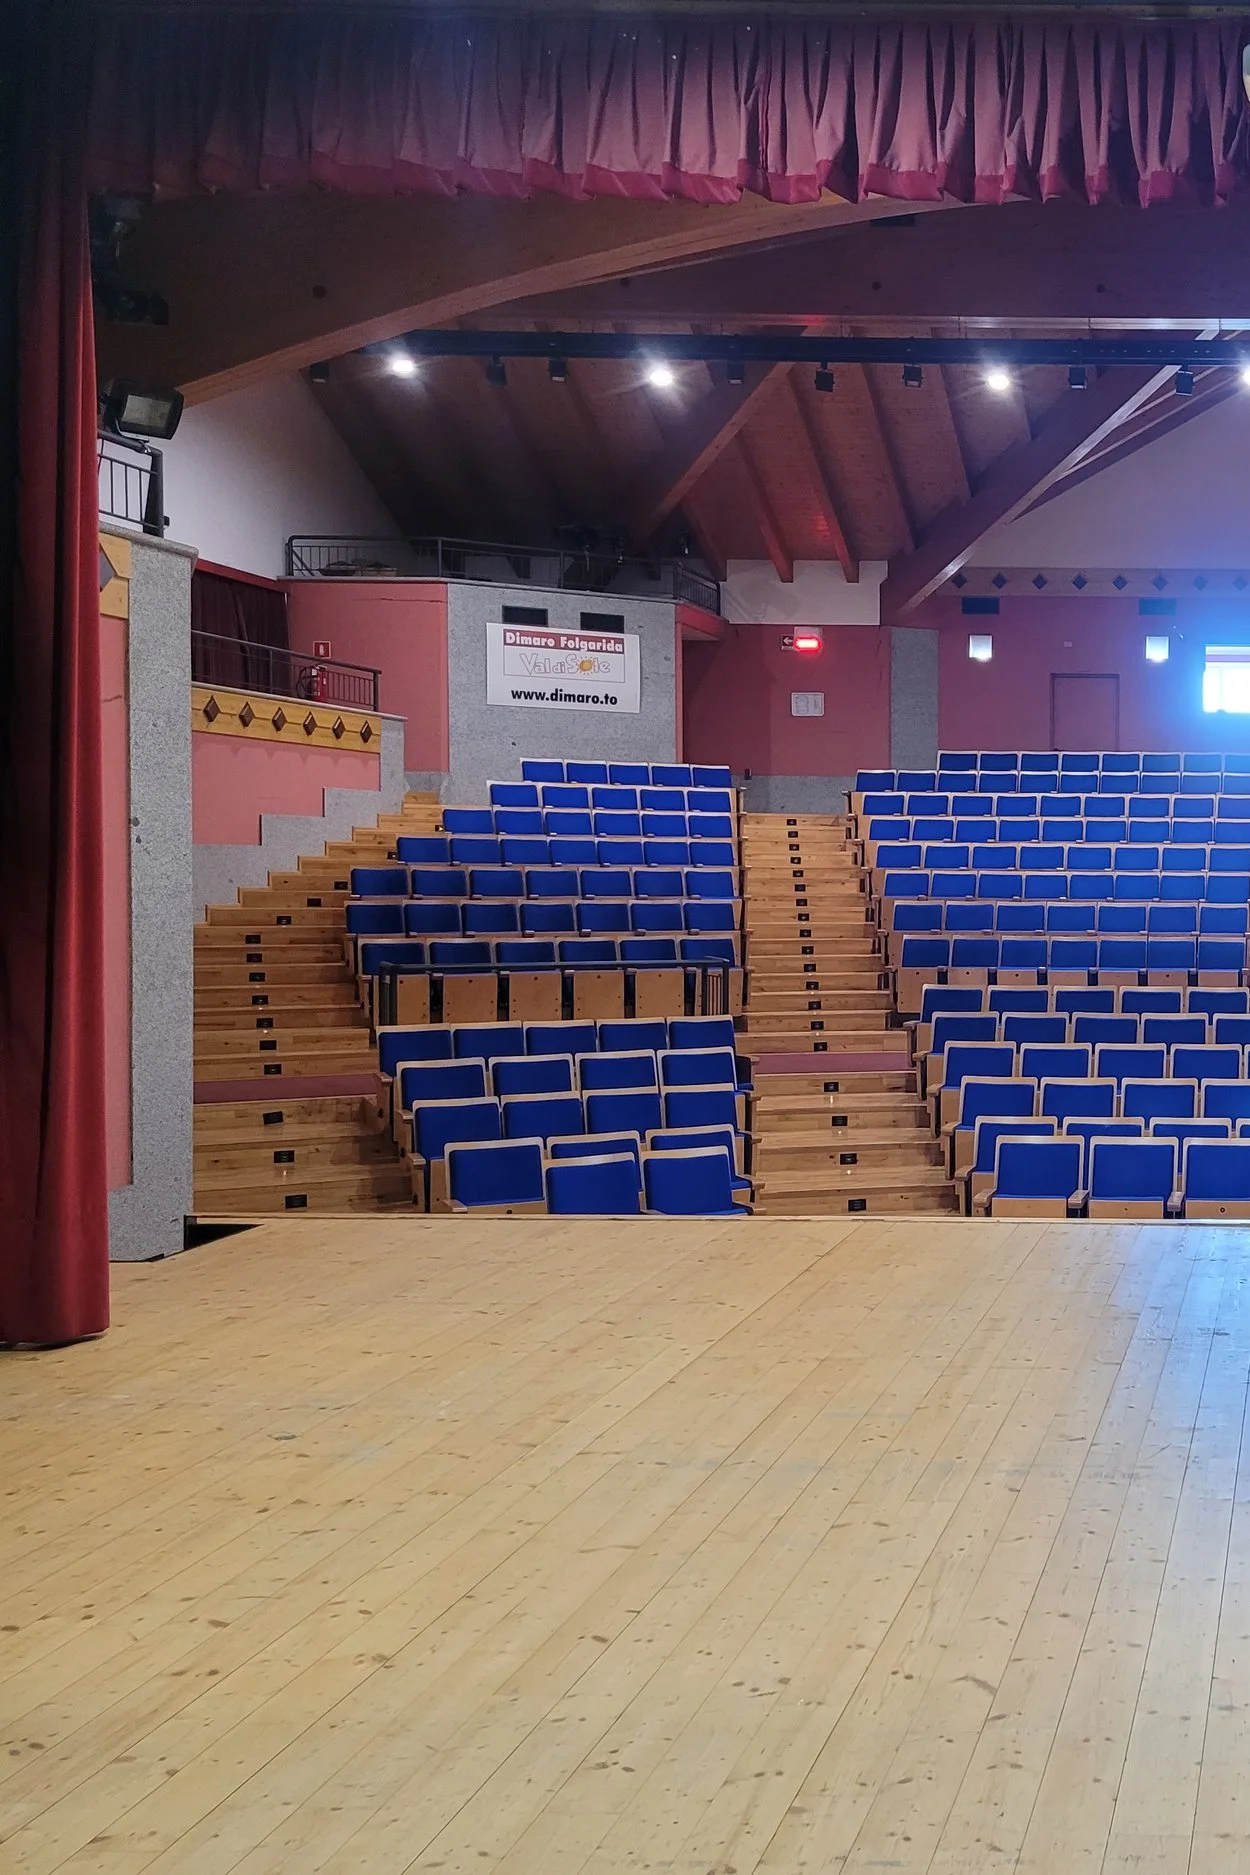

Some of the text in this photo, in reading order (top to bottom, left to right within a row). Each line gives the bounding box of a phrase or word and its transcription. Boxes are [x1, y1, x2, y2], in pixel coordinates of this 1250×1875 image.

[505, 632, 623, 652] Dimaro Folgarida
[519, 653, 611, 675] Val di Sole
[511, 688, 618, 706] www.dimaro.to
